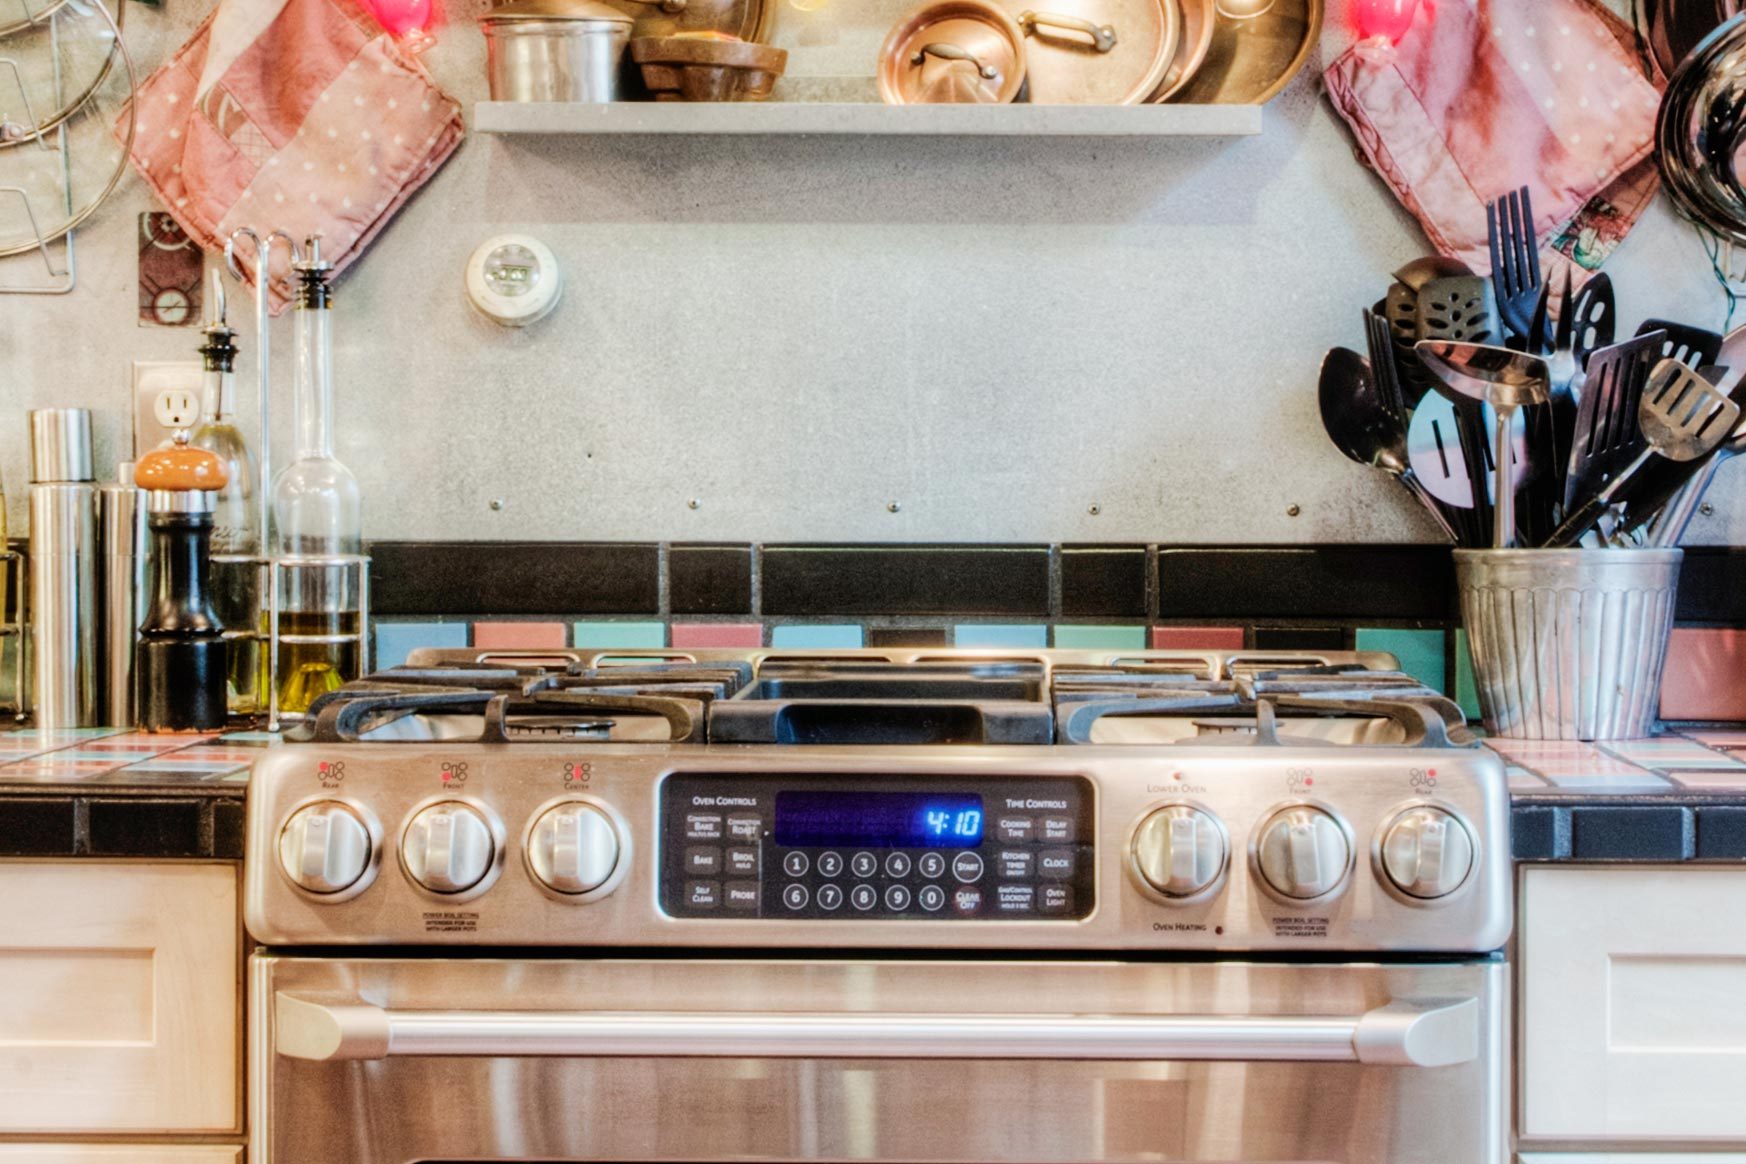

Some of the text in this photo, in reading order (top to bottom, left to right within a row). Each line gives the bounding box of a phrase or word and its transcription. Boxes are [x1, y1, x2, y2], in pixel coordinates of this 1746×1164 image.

[1181, 784, 1206, 793] OVEN
[693, 796, 757, 806] OVEN CONTROLS
[1006, 799, 1067, 809] TIME CONTROLS
[928, 811, 980, 836] 4:10
[793, 858, 937, 871] 1 2 3 4 5
[791, 891, 937, 904] 6 7 8 9 0
[1153, 922, 1207, 931] OVEN HEATING
